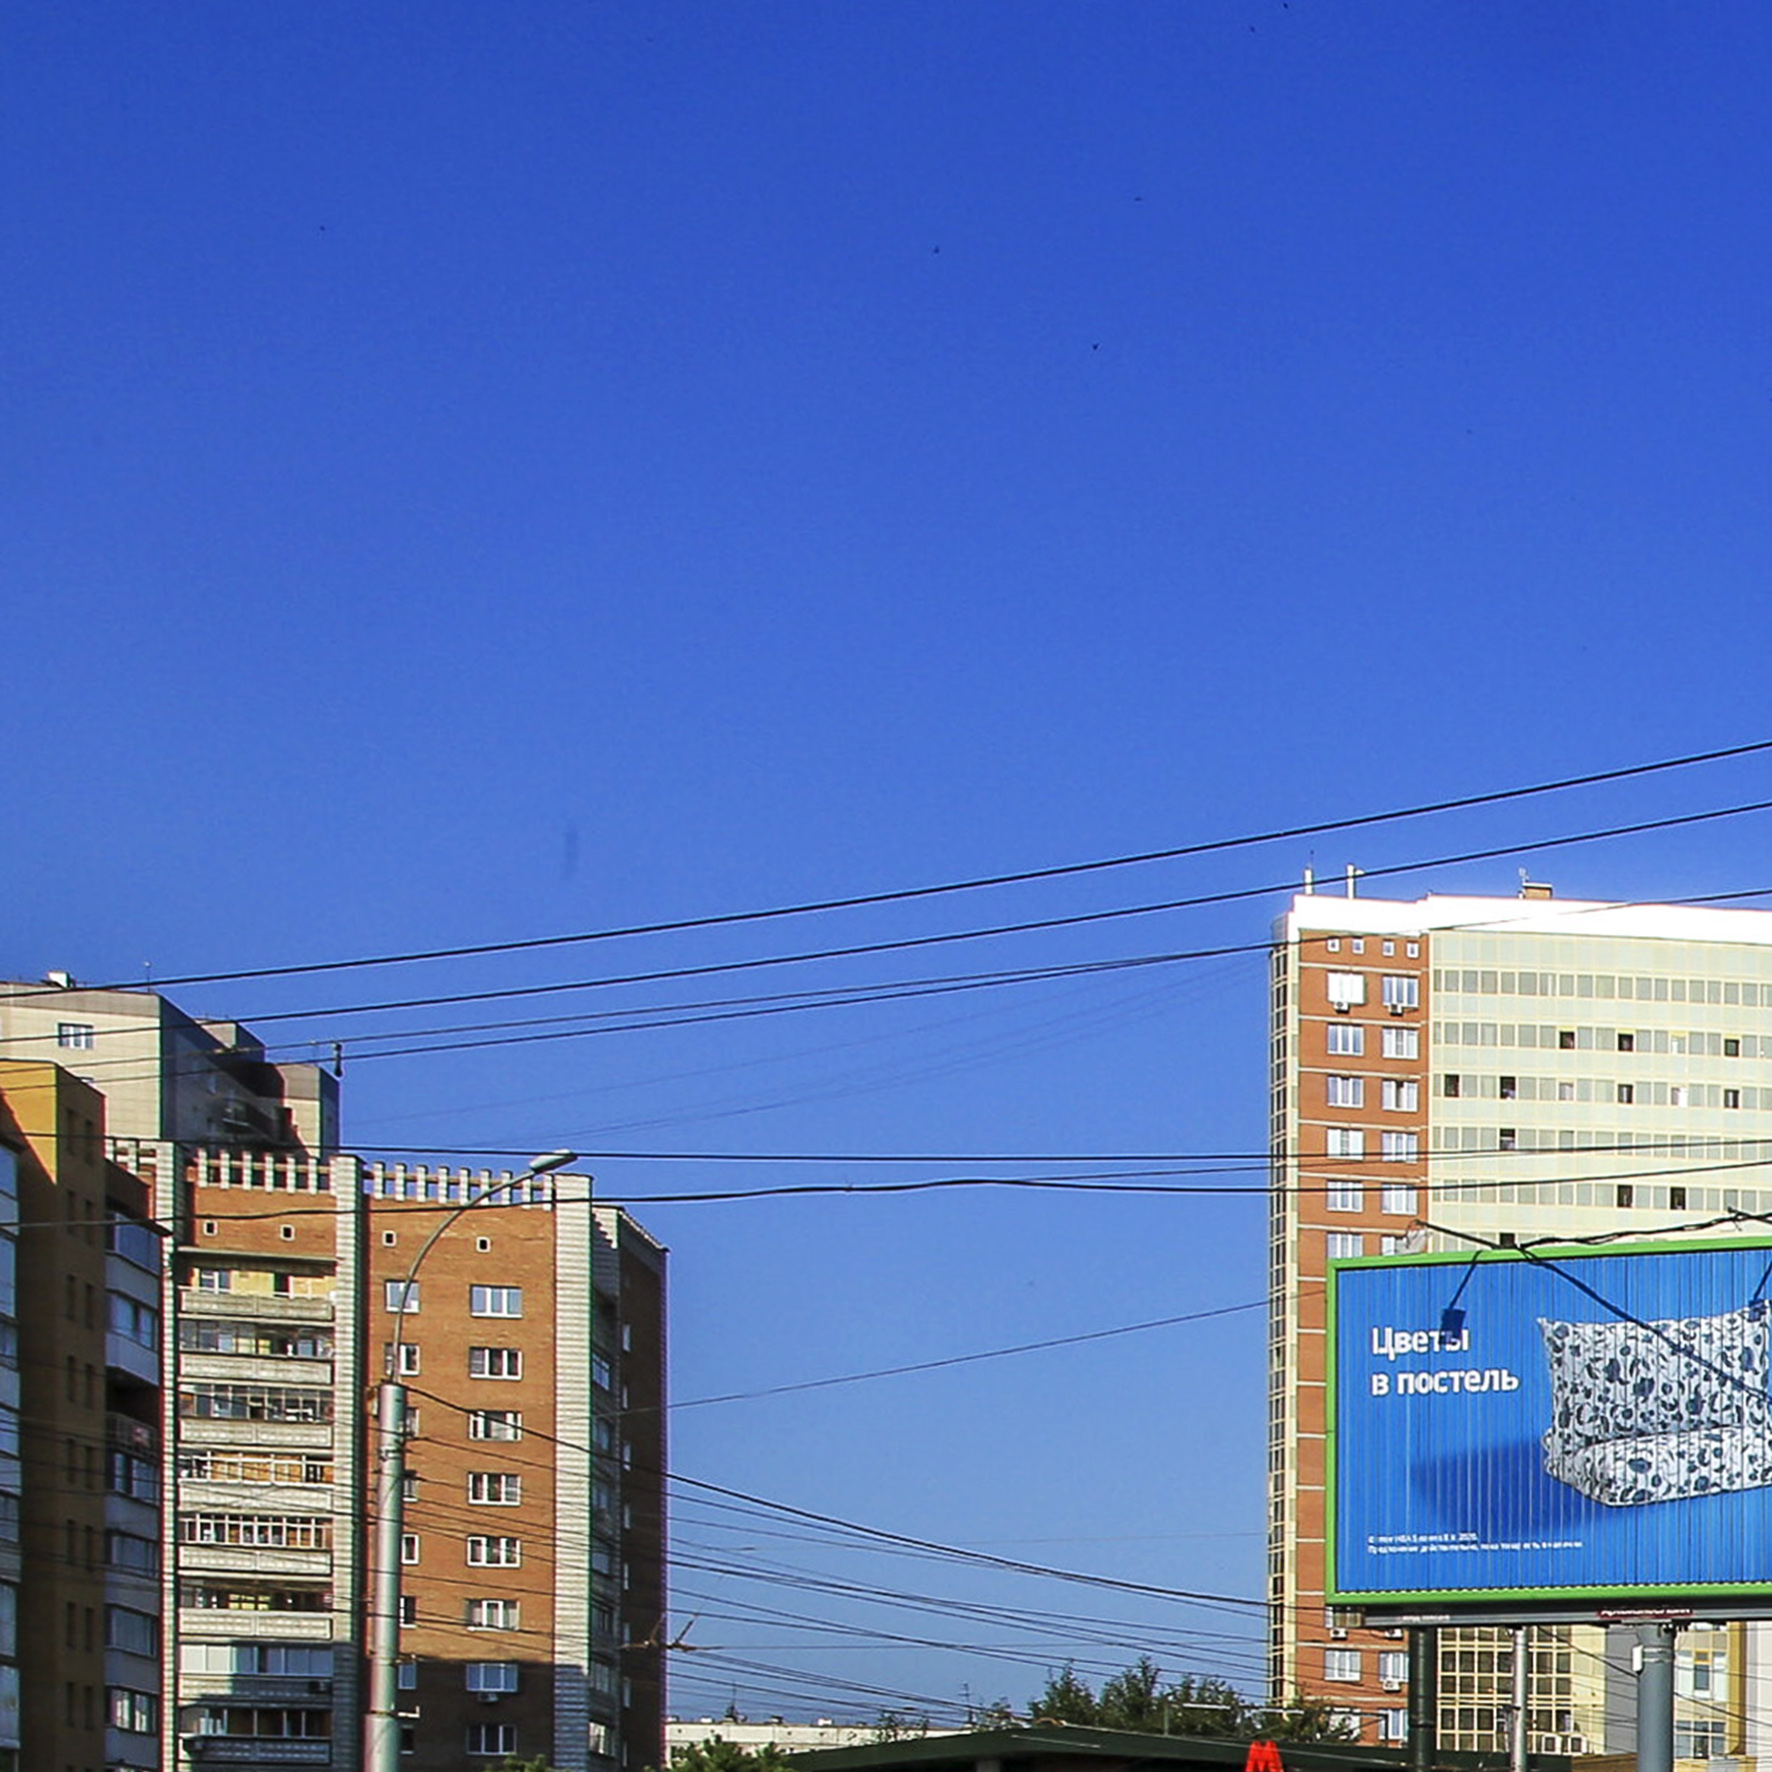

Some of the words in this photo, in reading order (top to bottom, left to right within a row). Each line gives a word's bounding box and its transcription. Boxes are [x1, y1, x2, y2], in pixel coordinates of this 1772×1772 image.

[1371, 1326, 1469, 1361] Цветы
[1371, 1372, 1389, 1396] в
[1396, 1368, 1519, 1396] постель
